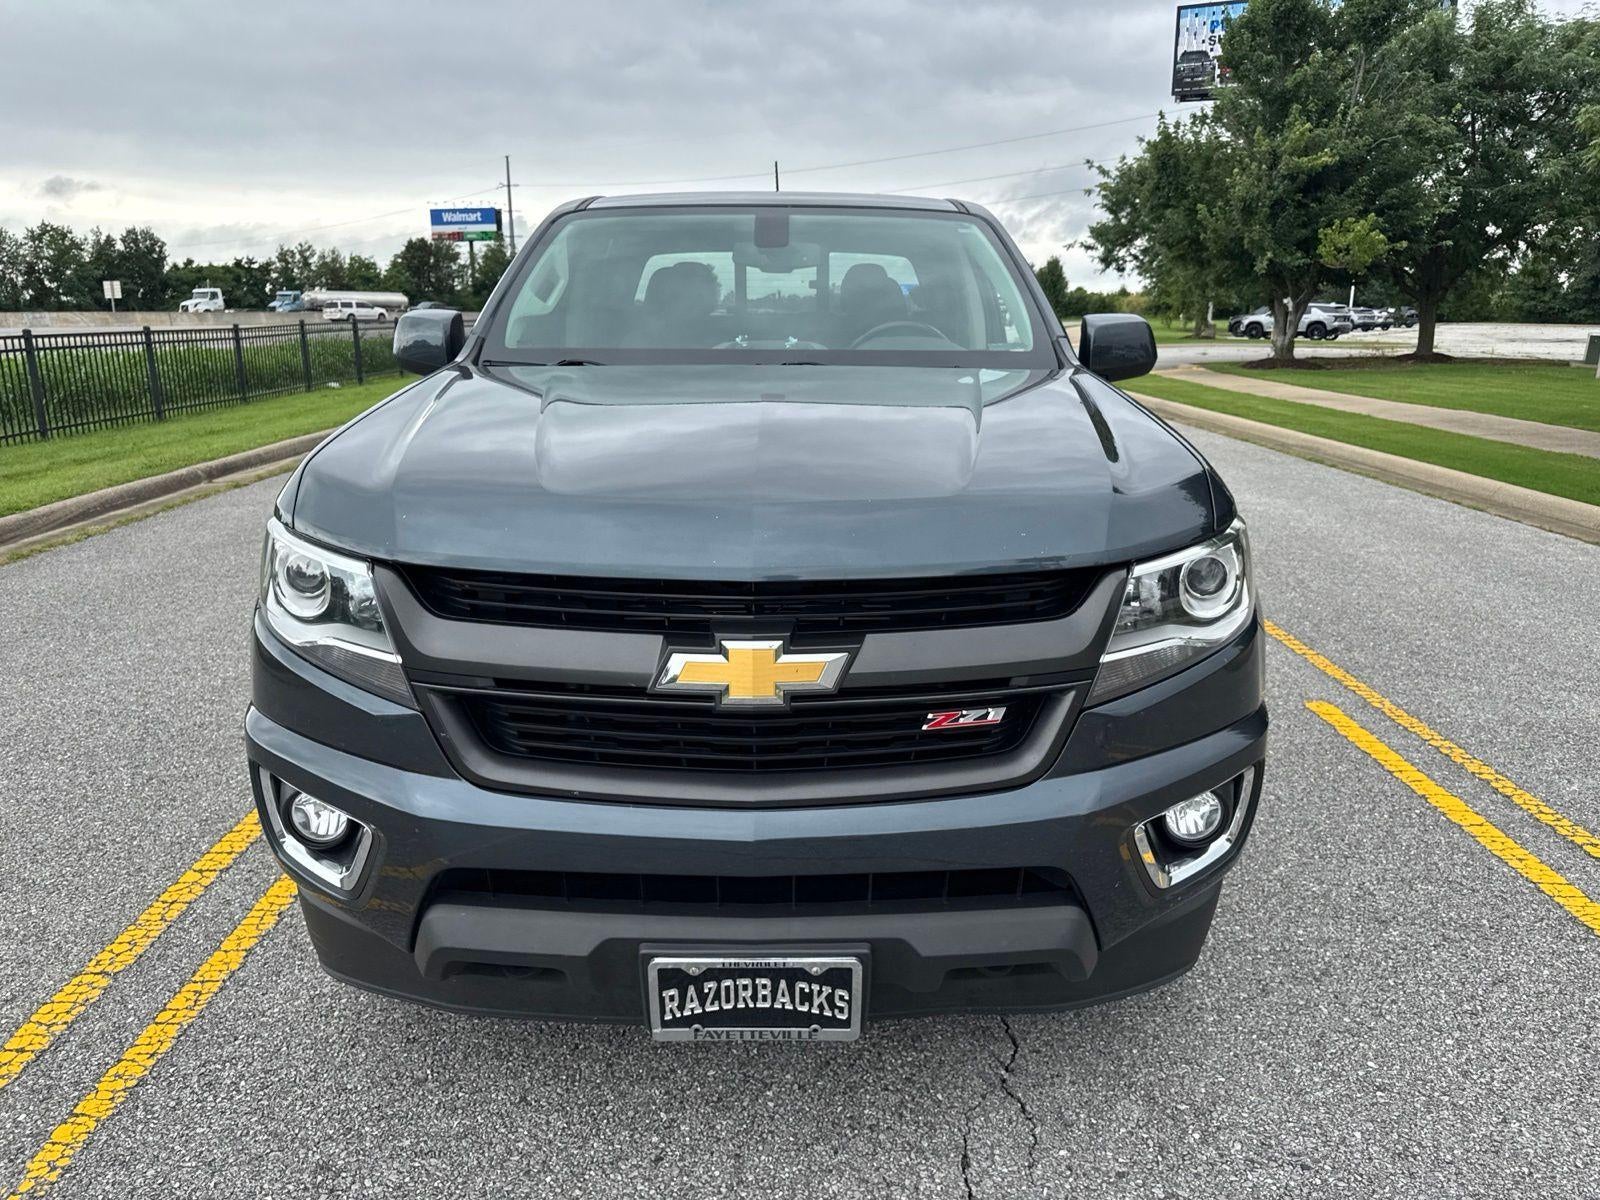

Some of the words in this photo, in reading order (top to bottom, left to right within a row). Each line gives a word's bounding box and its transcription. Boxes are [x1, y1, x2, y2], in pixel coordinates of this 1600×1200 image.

[441, 211, 482, 222] Walmart
[921, 706, 1007, 730] Z71
[662, 977, 849, 1020] RAZORBACKS
[693, 1030, 819, 1040] FAYETTEVILLE
